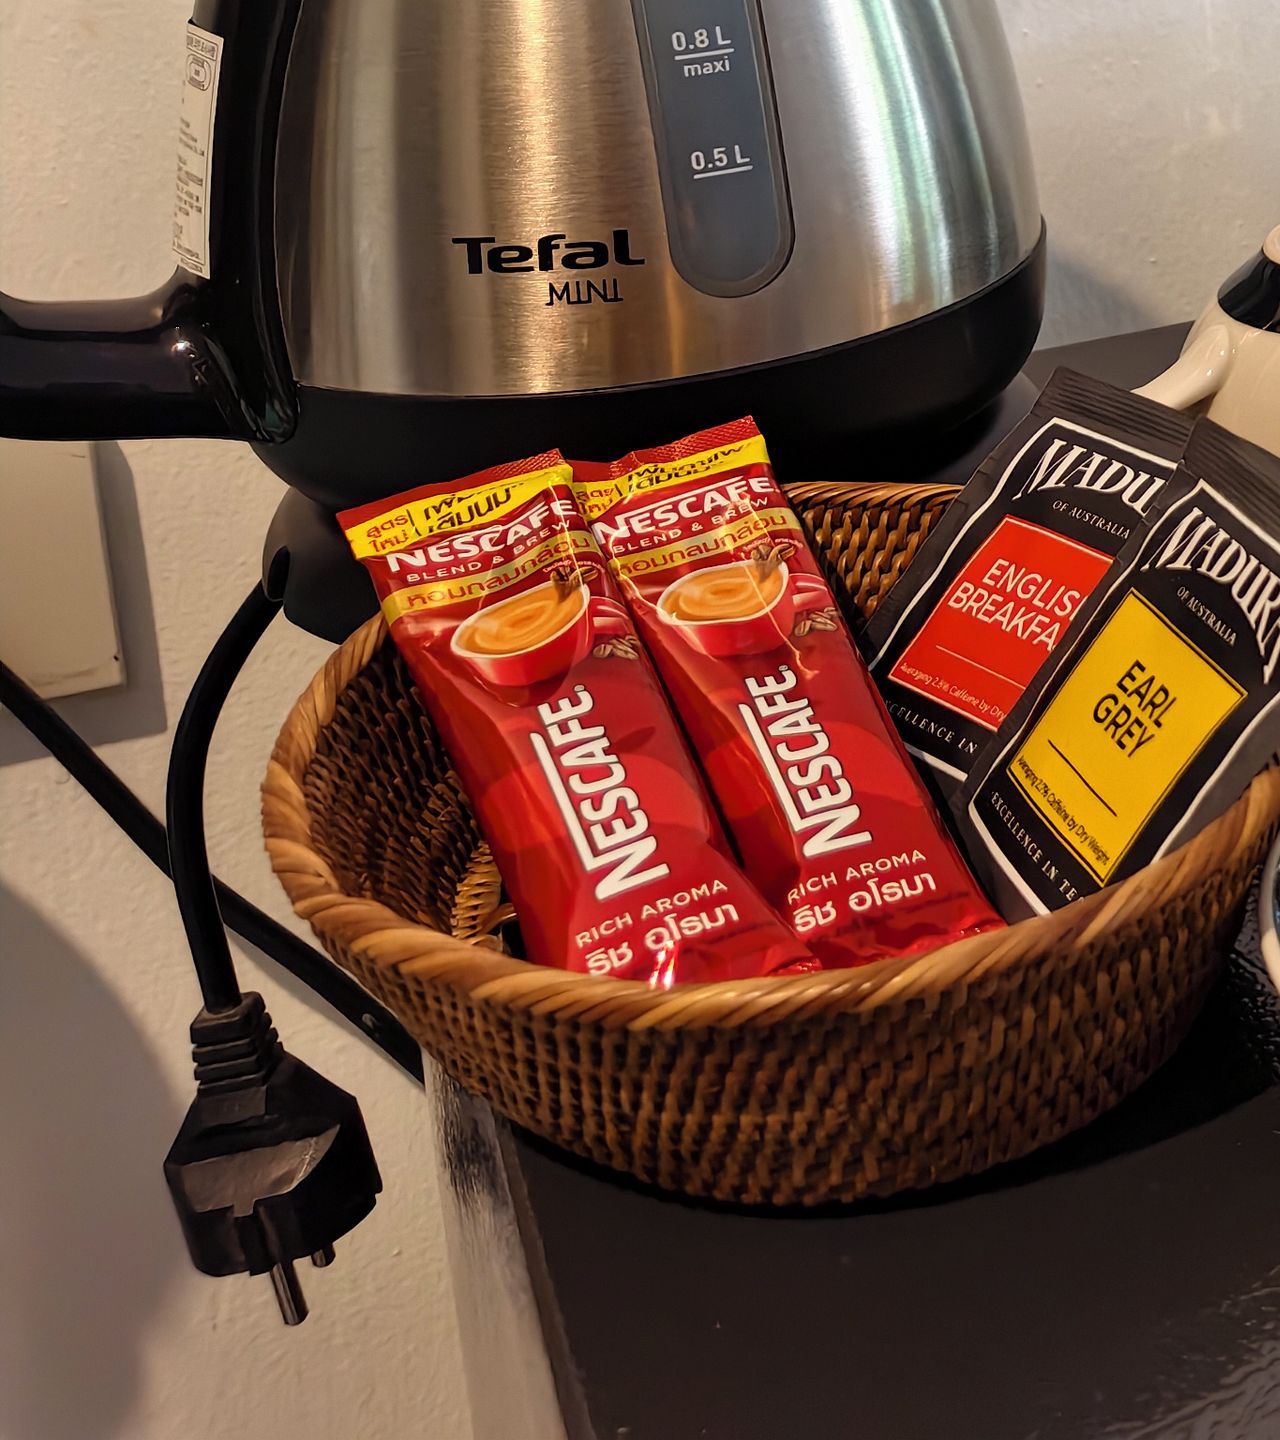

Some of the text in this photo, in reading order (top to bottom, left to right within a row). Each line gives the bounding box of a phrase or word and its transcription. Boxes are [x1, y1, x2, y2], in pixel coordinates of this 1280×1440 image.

[671, 26, 732, 52] 0.8 L
[683, 56, 731, 77] maxi
[691, 145, 751, 172] 0.5 L
[452, 229, 646, 275] Tefal
[545, 278, 624, 307] MINI
[612, 496, 769, 554] BLEND & BREW
[1052, 499, 1131, 540] OF AUSTRALIA
[406, 518, 571, 585] BLEND & BREW
[947, 580, 1062, 652] BREAKFA
[1176, 586, 1238, 647] OF AUSTRALIA
[979, 699, 991, 714] by
[1116, 658, 1178, 729] EARL
[958, 737, 978, 754] IN
[1092, 692, 1156, 759] GREY
[1066, 815, 1079, 832] by
[1076, 824, 1091, 844] Dry
[787, 847, 928, 905] RICH AROMA
[848, 869, 938, 915] อโรมา
[1042, 859, 1059, 882] IN
[574, 878, 729, 950] RICH AROMA
[643, 901, 740, 952] อโรมา
